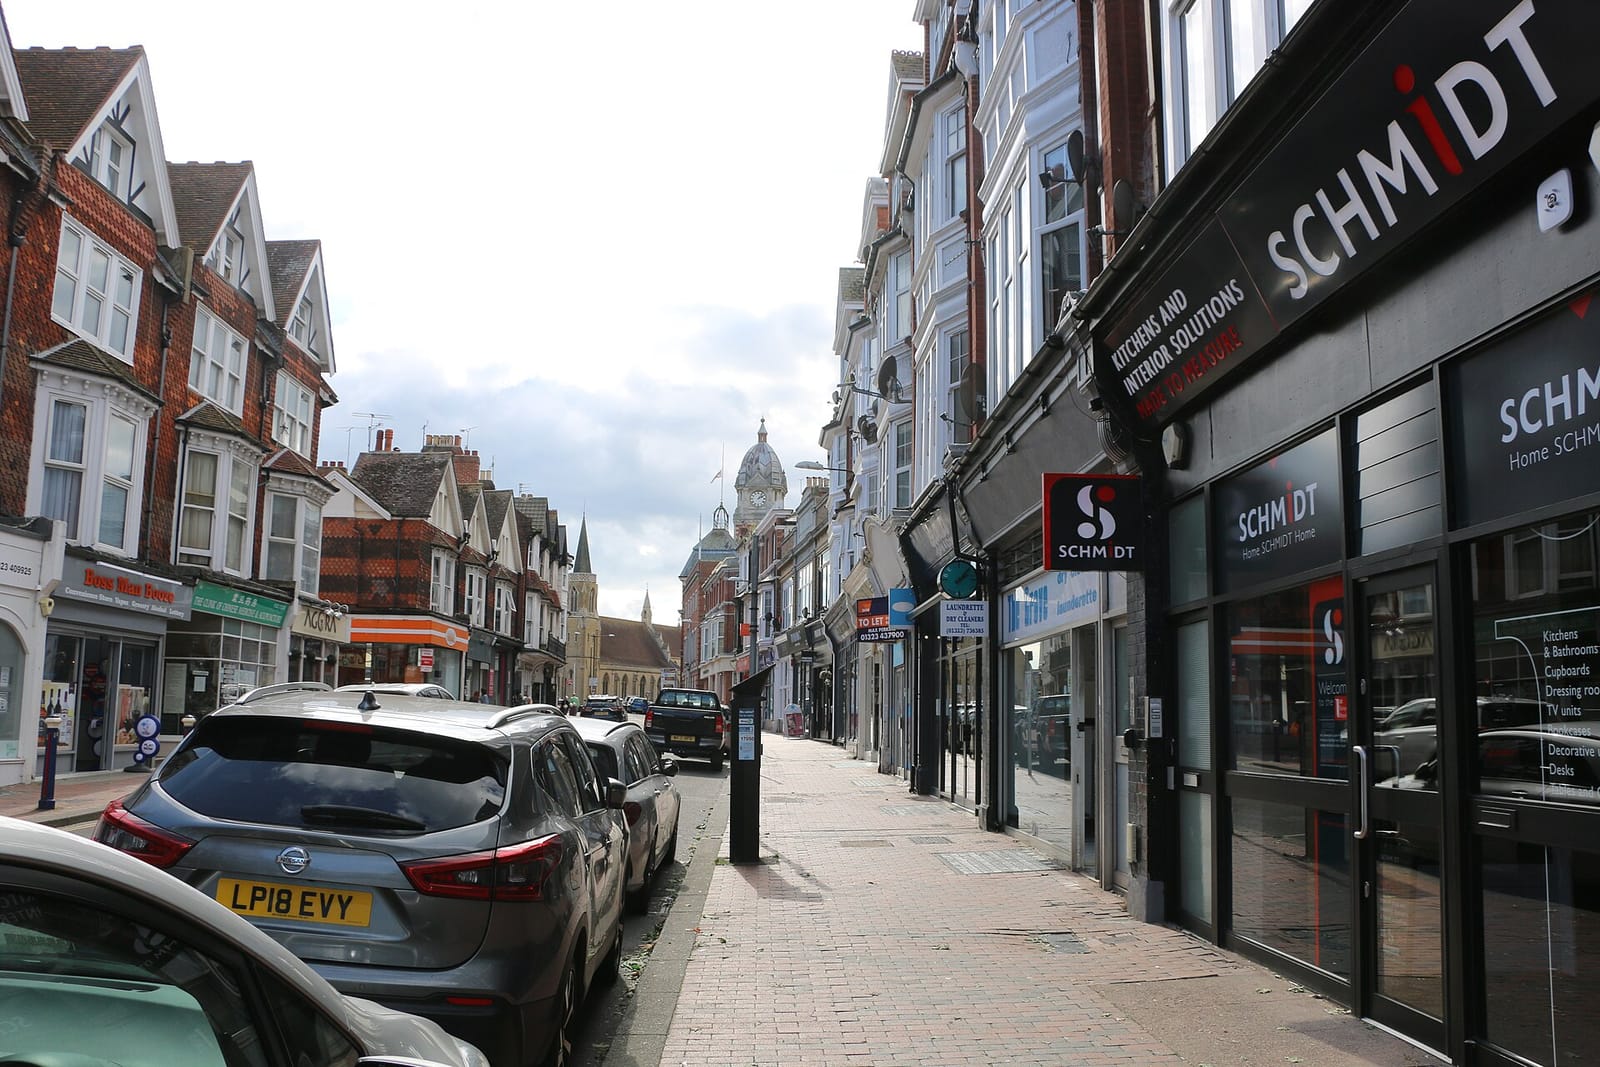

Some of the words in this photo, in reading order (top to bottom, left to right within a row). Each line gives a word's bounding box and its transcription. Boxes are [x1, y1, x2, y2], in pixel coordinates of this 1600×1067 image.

[1111, 314, 1161, 371] KITCHENS
[1158, 289, 1188, 326] AND
[1123, 344, 1173, 396] INTERIOR
[1169, 278, 1245, 355] SOLUTIONS
[1136, 386, 1167, 418] MADE
[1165, 373, 1185, 397] TO
[1182, 325, 1244, 384] MEASURE
[1509, 447, 1549, 471] Home
[1242, 547, 1260, 560] Home
[1261, 531, 1293, 554] SCHMIDT
[1294, 527, 1316, 542] Home
[83, 567, 115, 592] Boss
[116, 576, 143, 597] Man
[143, 582, 176, 604] Booze
[858, 618, 870, 628] TO
[871, 616, 884, 626] LET
[860, 633, 878, 641] 01323
[879, 631, 905, 639] 437900
[1543, 629, 1579, 642] Kitchens
[1544, 646, 1551, 658] &
[1552, 644, 1599, 658] Bathrooms
[1544, 663, 1591, 680] Cupboards
[1545, 684, 1582, 699] Dressing
[1547, 704, 1559, 716] TV
[1561, 705, 1582, 716] units
[1548, 744, 1596, 757] Decorative
[1549, 763, 1575, 776] Desks
[231, 884, 293, 914] LP18
[299, 891, 353, 920] EVY
